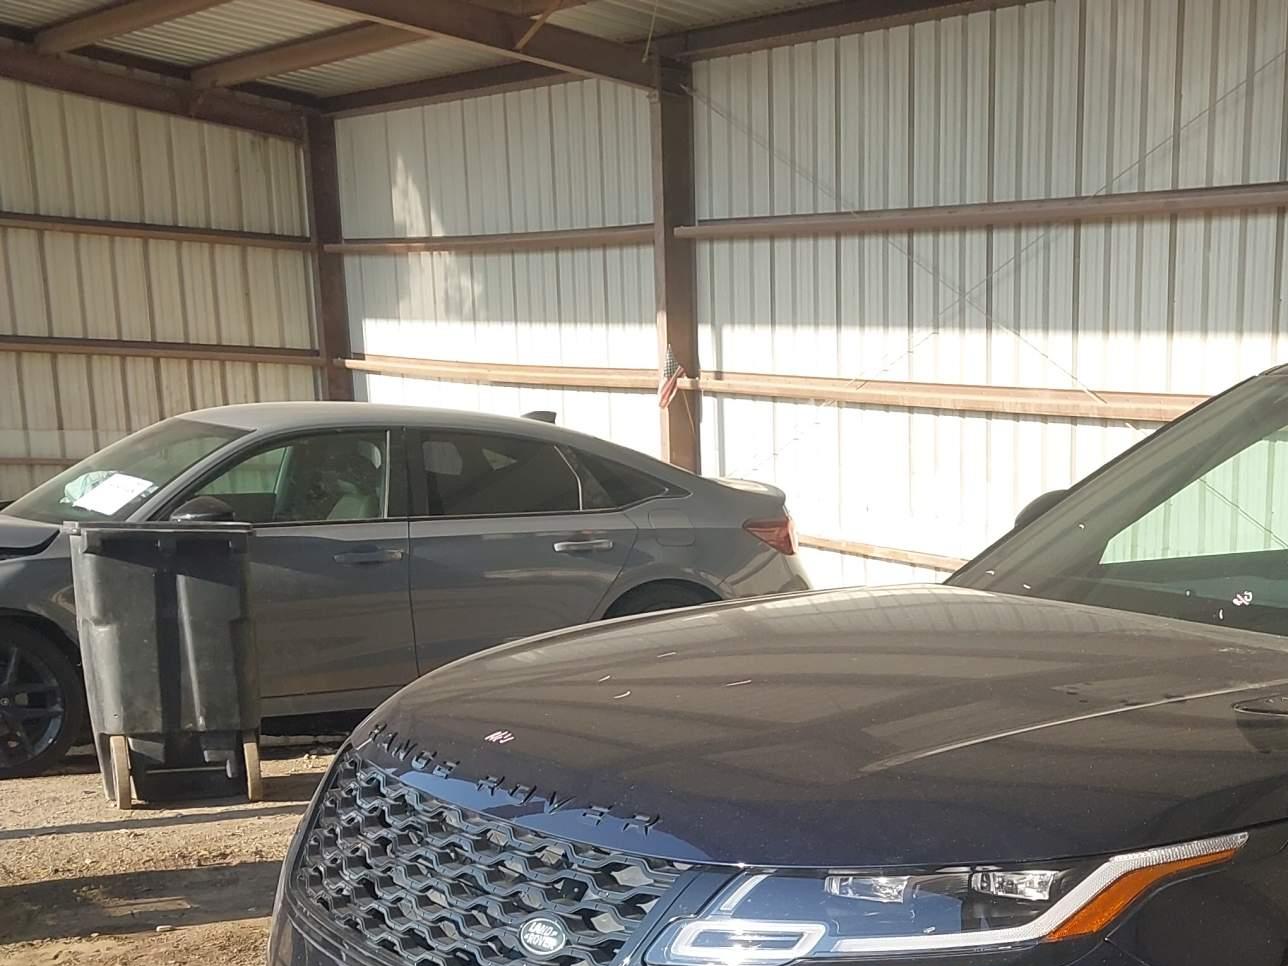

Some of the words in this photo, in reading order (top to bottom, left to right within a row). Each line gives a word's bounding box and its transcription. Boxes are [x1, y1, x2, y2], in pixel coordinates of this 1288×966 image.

[368, 723, 461, 780] RANGE
[474, 776, 661, 837] ROVER
[528, 922, 554, 937] LAND
